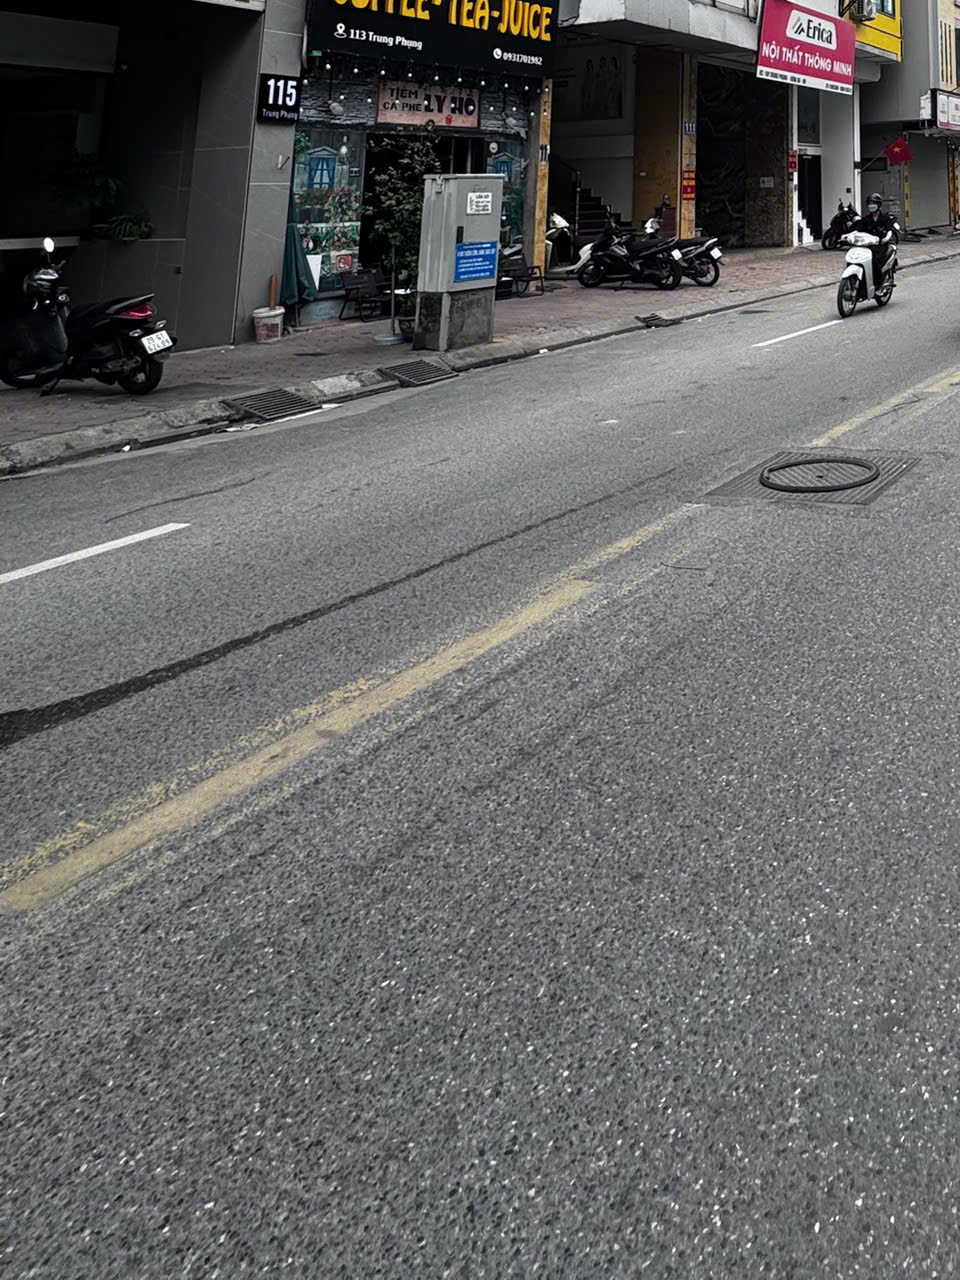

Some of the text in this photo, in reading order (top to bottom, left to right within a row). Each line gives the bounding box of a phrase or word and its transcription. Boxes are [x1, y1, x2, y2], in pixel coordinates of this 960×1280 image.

[349, 29, 423, 50] 113 Trung Phụng
[806, 19, 833, 45] Erica
[762, 40, 852, 77] NỘI THẤT THÔNG MINH
[267, 78, 297, 106] 115
